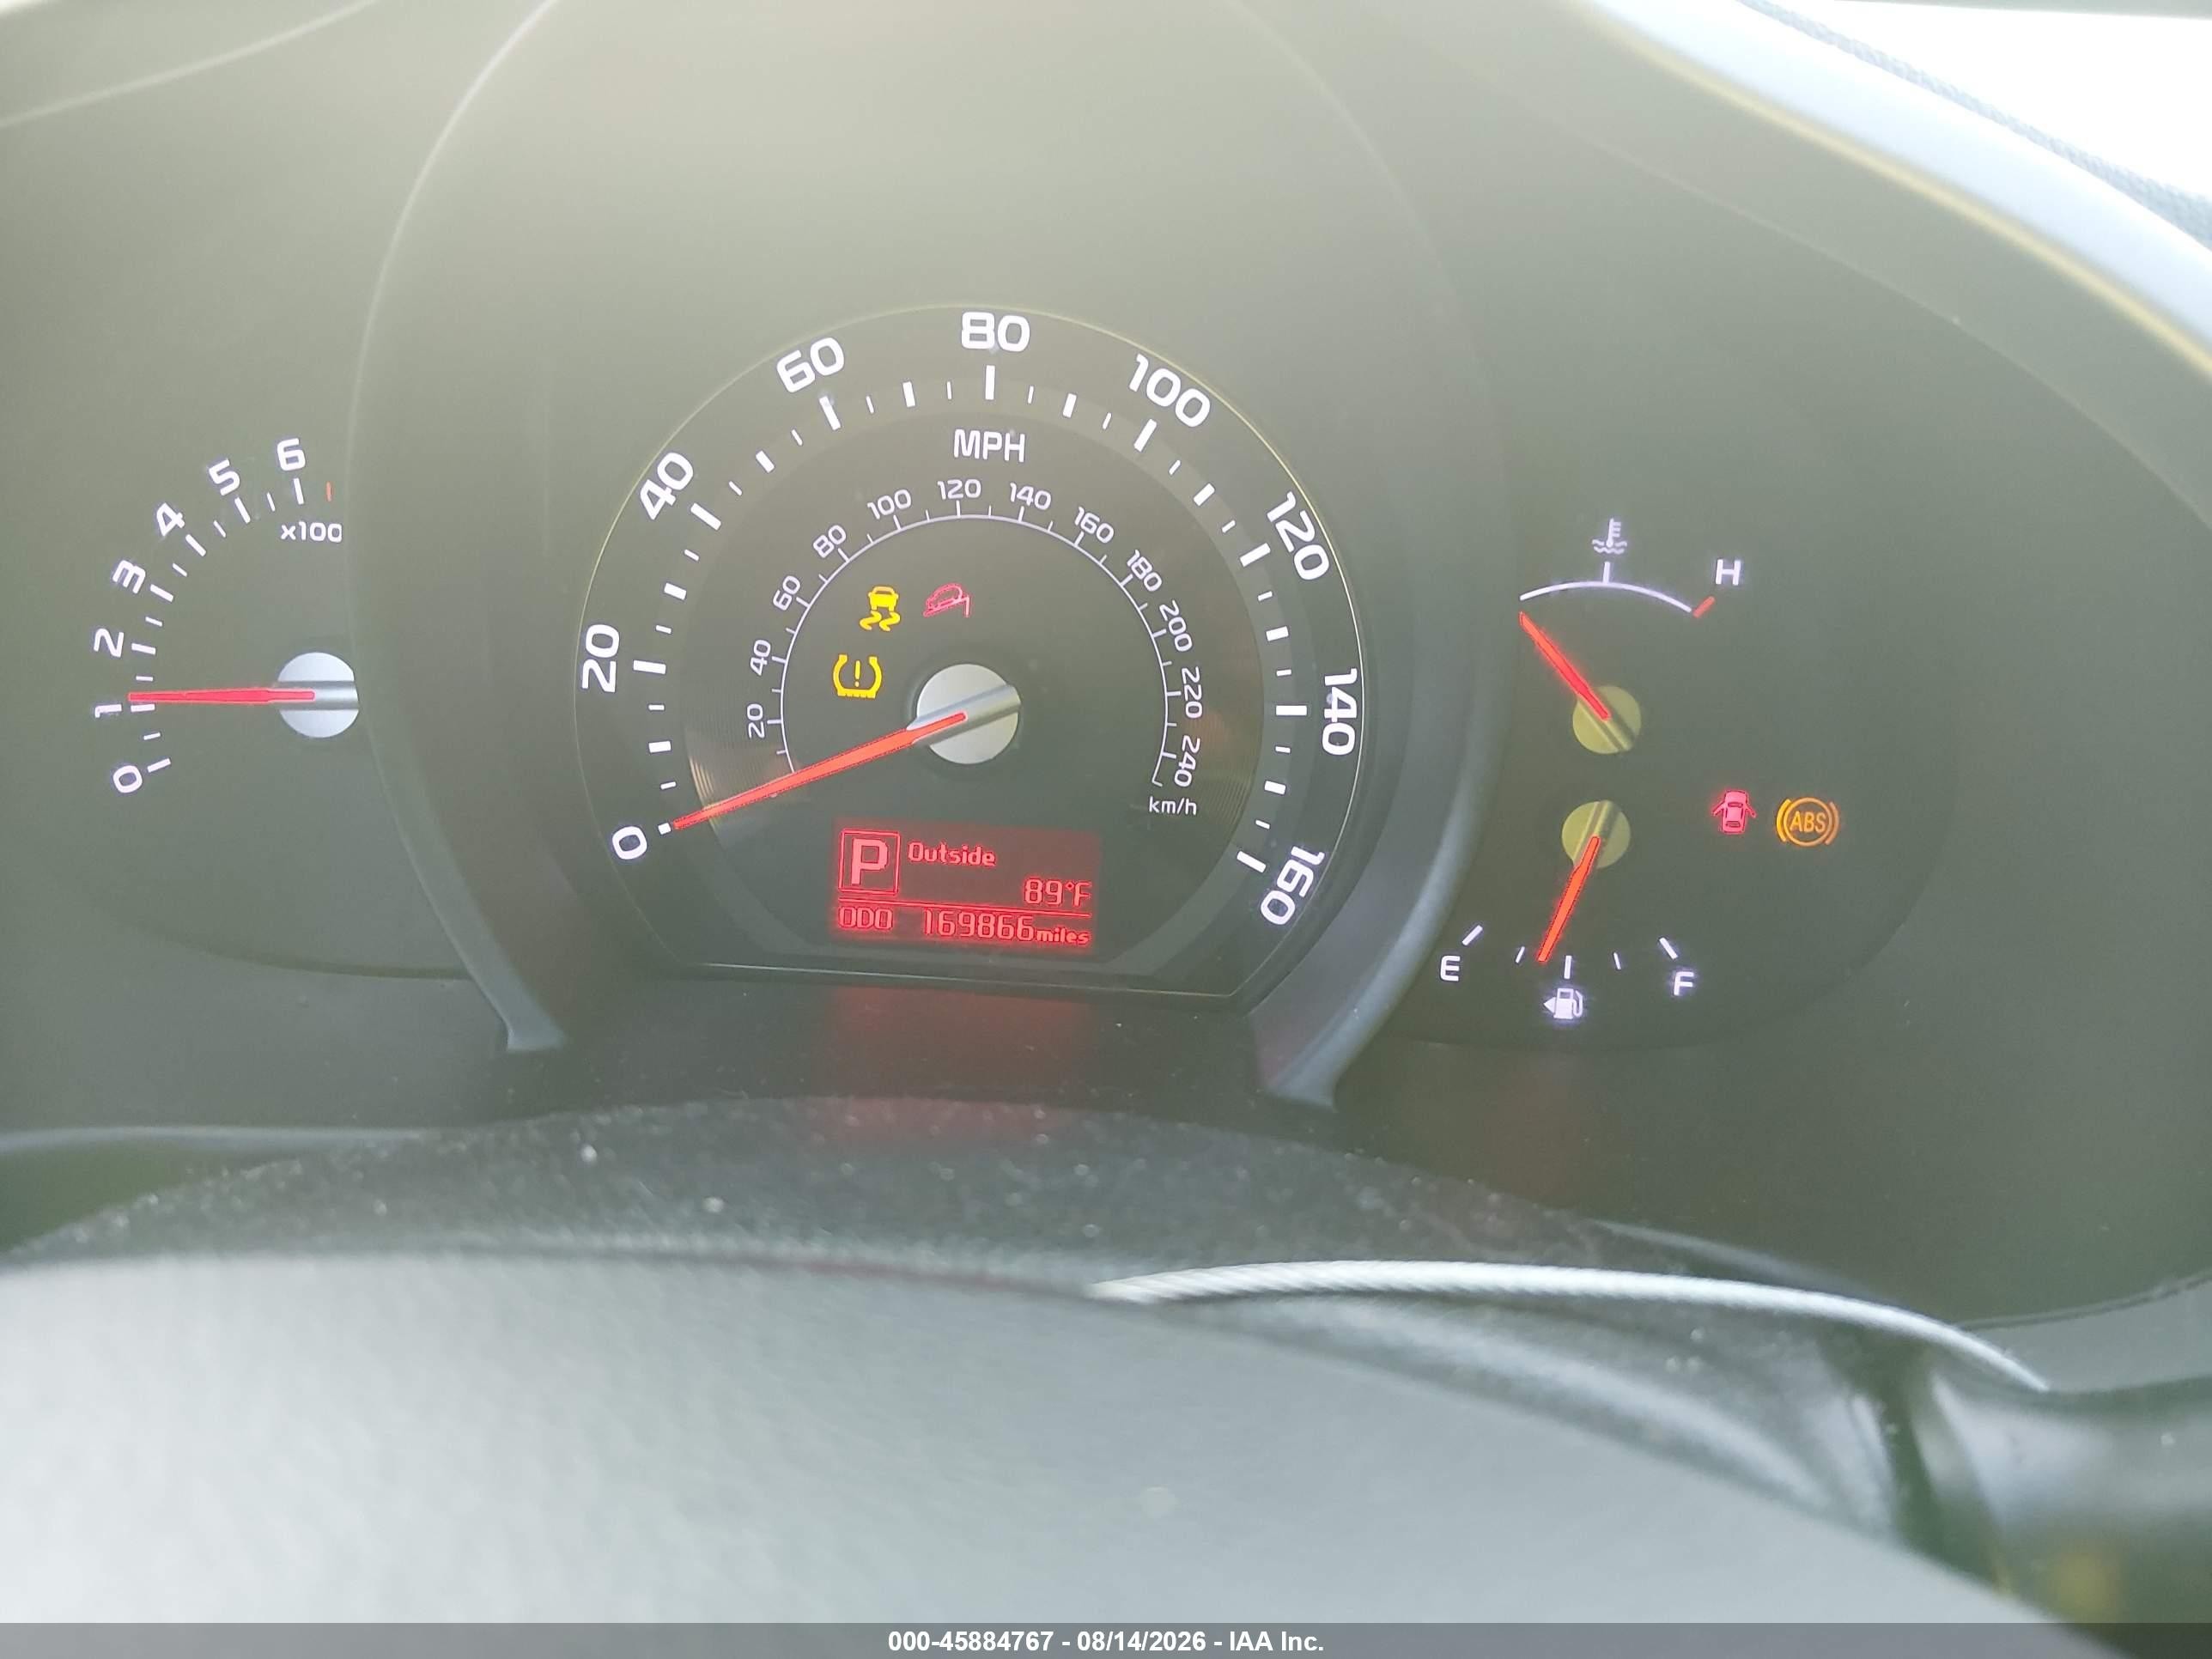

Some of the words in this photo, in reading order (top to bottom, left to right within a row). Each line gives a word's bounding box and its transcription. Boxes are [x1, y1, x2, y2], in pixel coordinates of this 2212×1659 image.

[961, 312, 1030, 352] 80
[776, 337, 845, 393] 60
[1128, 353, 1211, 428] 100
[276, 438, 306, 471] 6
[953, 428, 1026, 463] MPH
[208, 459, 240, 495] 5
[640, 452, 694, 520] 40
[937, 478, 981, 500] 120
[866, 489, 912, 520] 100
[1009, 483, 1052, 511] 140
[155, 502, 185, 537] 4
[1073, 506, 1115, 544] 160
[1267, 491, 1329, 580] 120
[812, 525, 847, 558] 80
[112, 560, 146, 594] 3
[1127, 550, 1163, 592] 180
[1716, 559, 1741, 586] H
[773, 575, 800, 611] 60
[93, 629, 125, 658] 2
[1159, 599, 1193, 653] 200
[582, 624, 620, 693] 20
[750, 639, 771, 676] 40
[1182, 666, 1202, 719] 220
[94, 703, 122, 718] 1
[746, 703, 765, 739] 20
[1322, 668, 1358, 756] 140
[1174, 735, 1200, 787] 240
[112, 765, 143, 793] 0
[1148, 797, 1197, 816] km/h
[1789, 811, 1826, 835] ABS
[611, 825, 647, 860] 0
[908, 841, 996, 866] Outside
[851, 838, 888, 885] P
[1024, 878, 1092, 907] 89°F
[1260, 846, 1325, 925] 160
[838, 906, 893, 930] ODO
[1440, 955, 1460, 981] E
[1674, 971, 1694, 996] F
